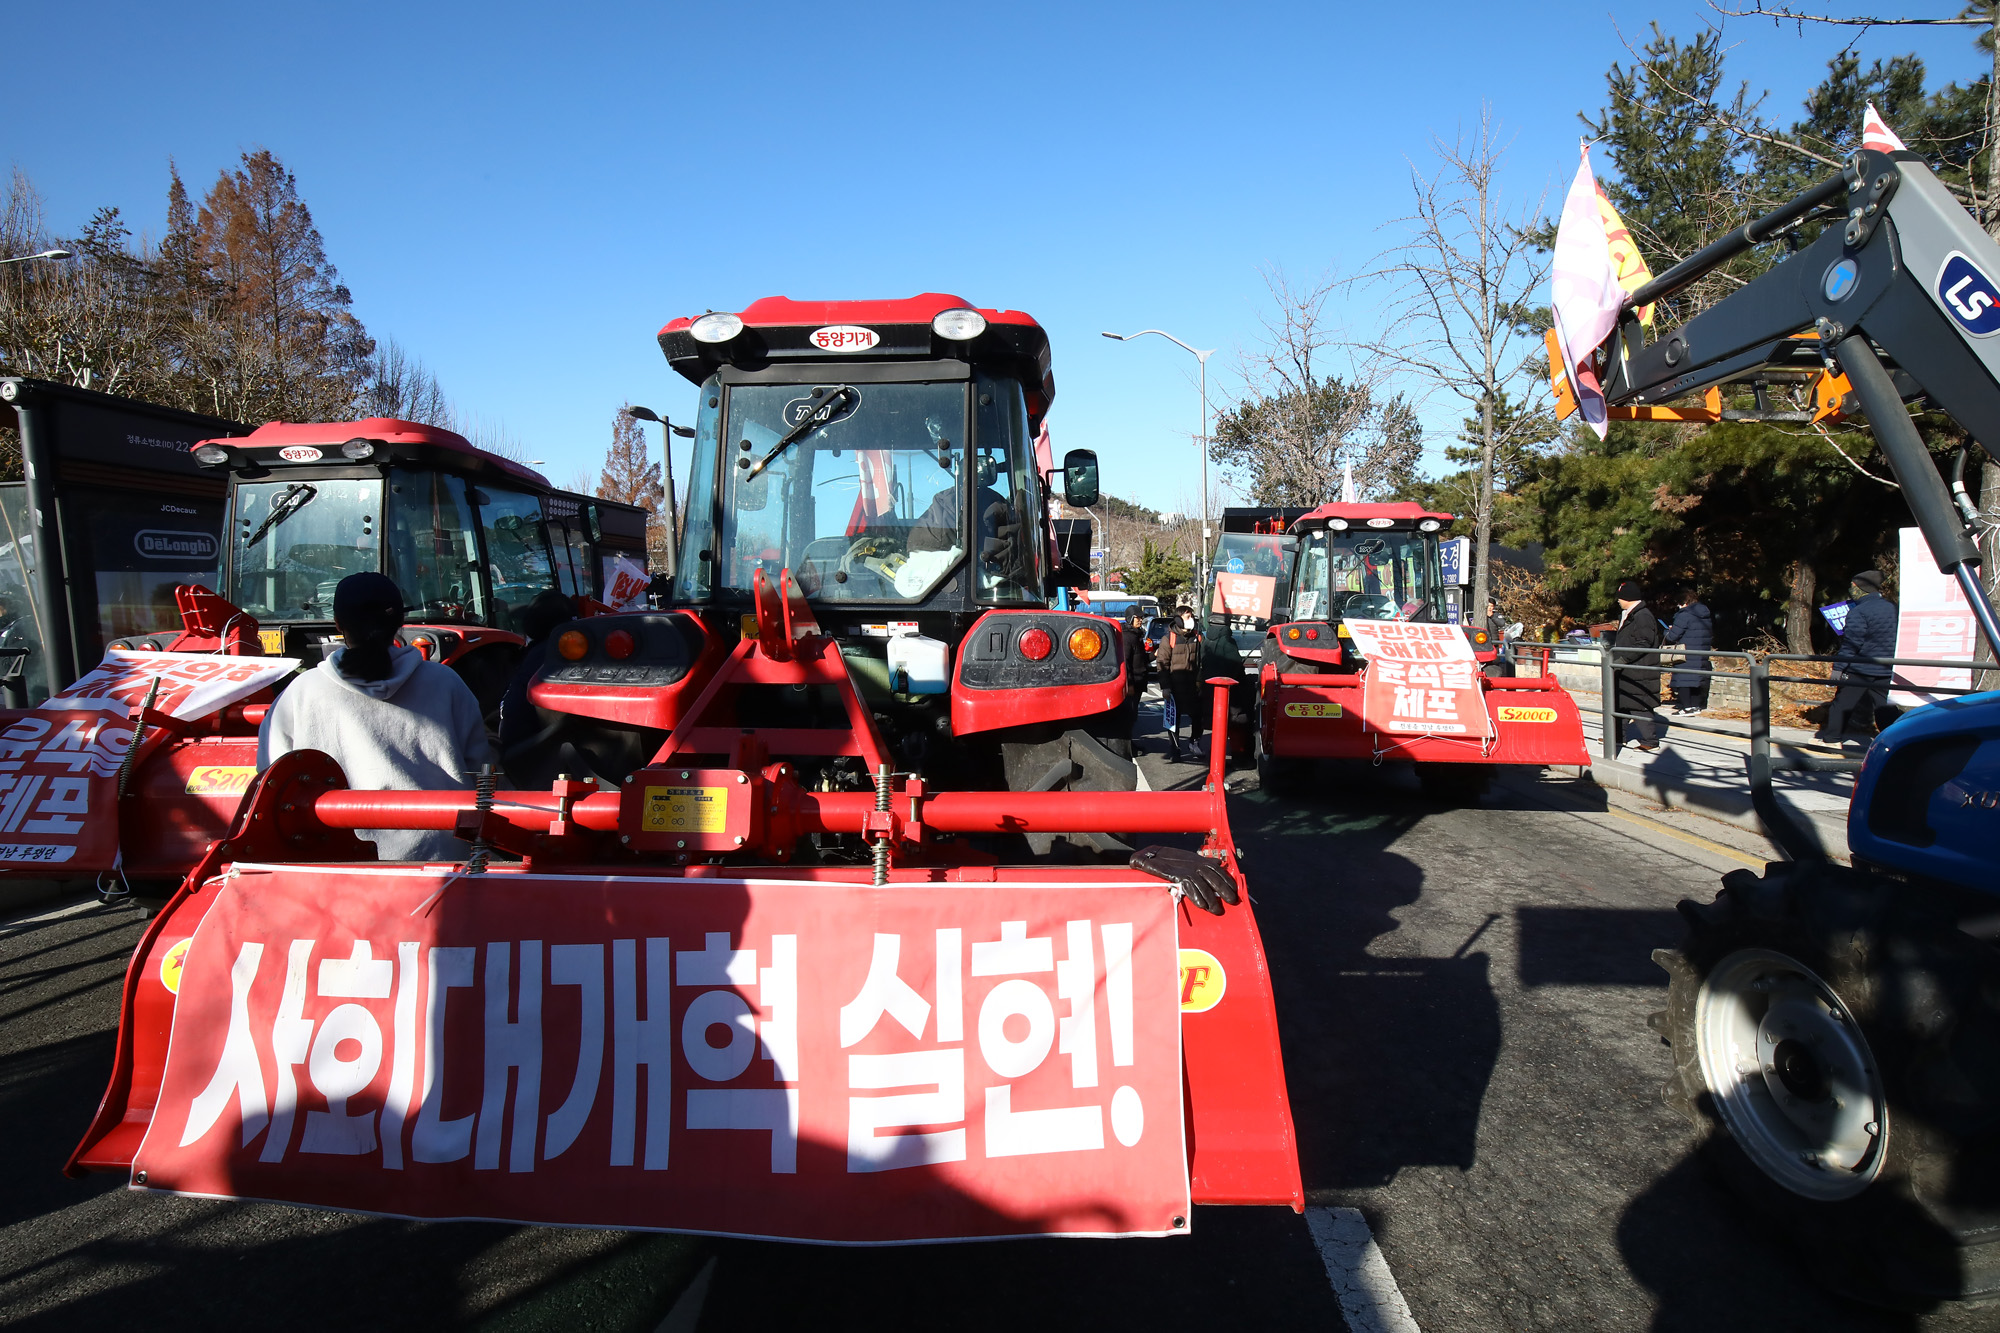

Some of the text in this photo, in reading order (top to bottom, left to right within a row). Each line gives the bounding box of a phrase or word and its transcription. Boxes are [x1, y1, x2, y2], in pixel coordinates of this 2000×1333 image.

[1945, 275, 1994, 320] LS
[816, 332, 872, 347] 동양기계
[795, 405, 831, 420] TM
[127, 435, 174, 449] 정류소번호(ID)
[283, 449, 319, 460] 동양기계
[161, 504, 197, 515] JCDecaux
[1251, 597, 1261, 612] 3
[1355, 624, 1455, 641] 국민의힘
[1378, 640, 1448, 660] 해체
[1376, 659, 1473, 689] 윤석열
[1299, 704, 1326, 716] 동양
[1393, 685, 1459, 720] 체포
[1504, 708, 1553, 720] S200CF
[19, 846, 57, 860] 투쟁단
[1180, 966, 1211, 1005] F
[178, 920, 1144, 1174] 사회대개혁 실현!
